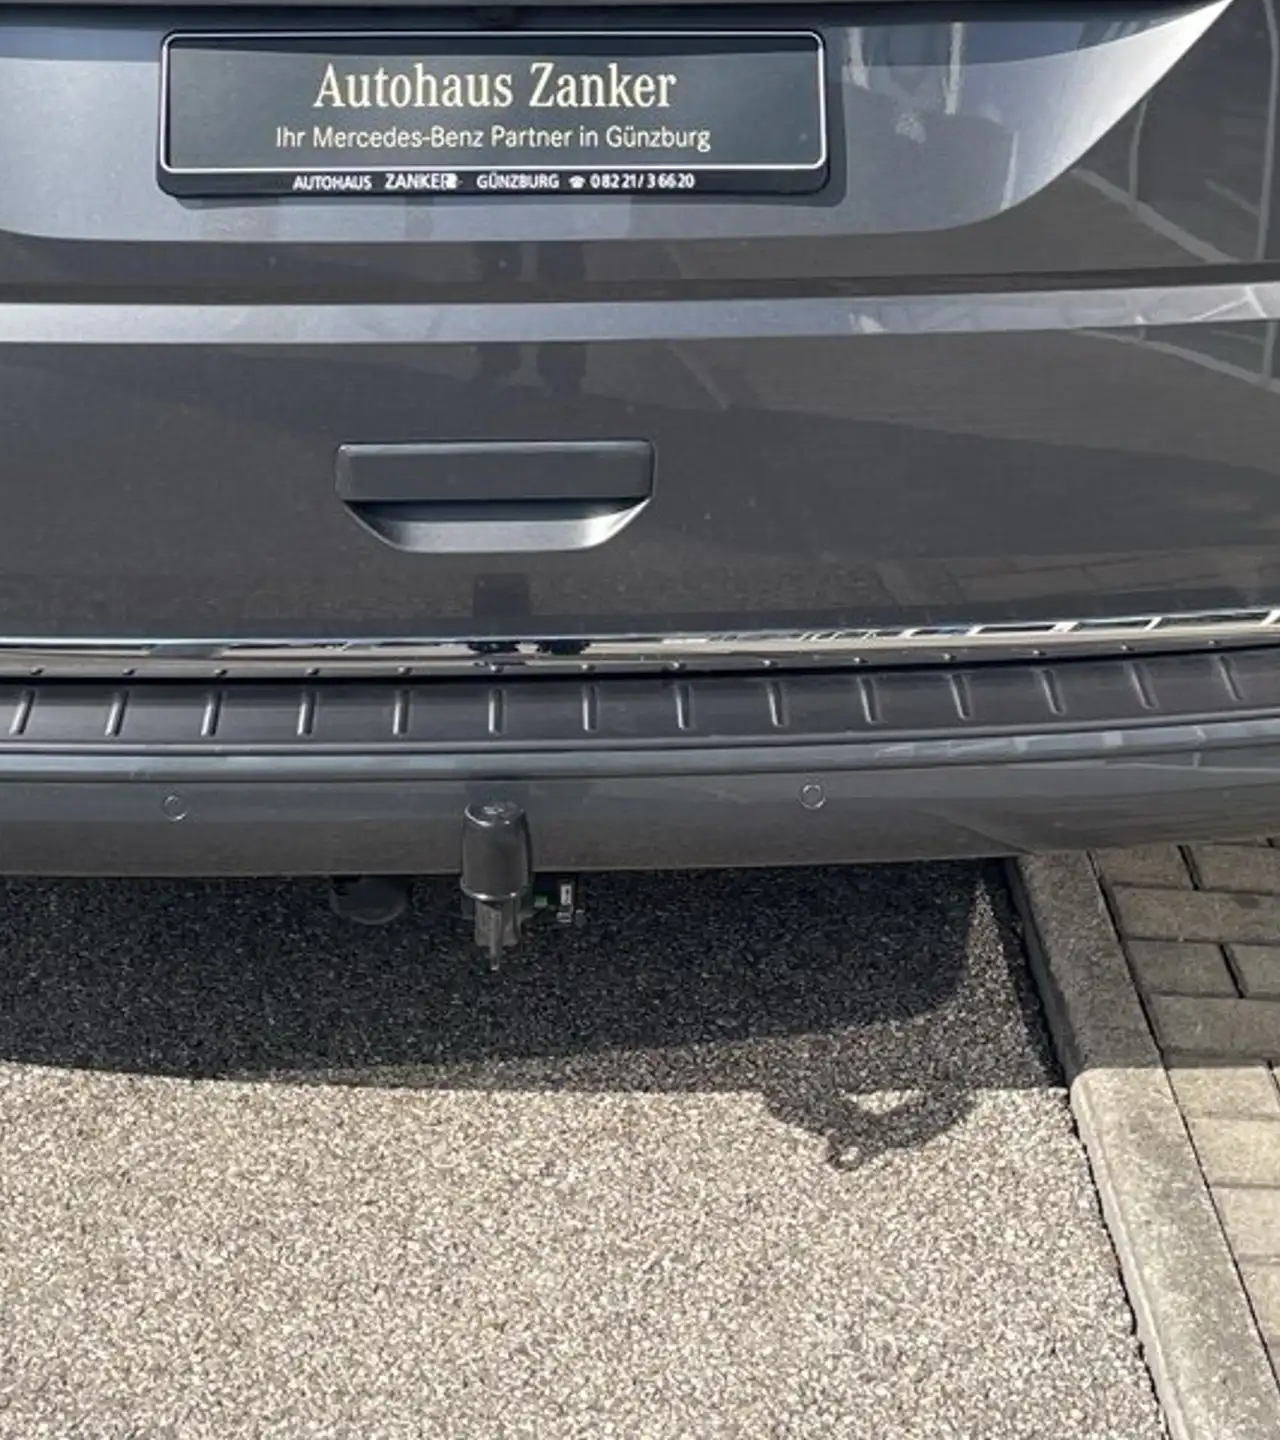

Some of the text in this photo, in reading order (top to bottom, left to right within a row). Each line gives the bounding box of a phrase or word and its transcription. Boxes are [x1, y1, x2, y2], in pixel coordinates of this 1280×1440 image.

[312, 62, 677, 108] Autohaus Zanker
[276, 124, 711, 153] Ihr Mercedes-Benz Partner in Günzburg
[292, 174, 372, 190] AUTOHAUS
[476, 172, 560, 190] GÜNZBURG
